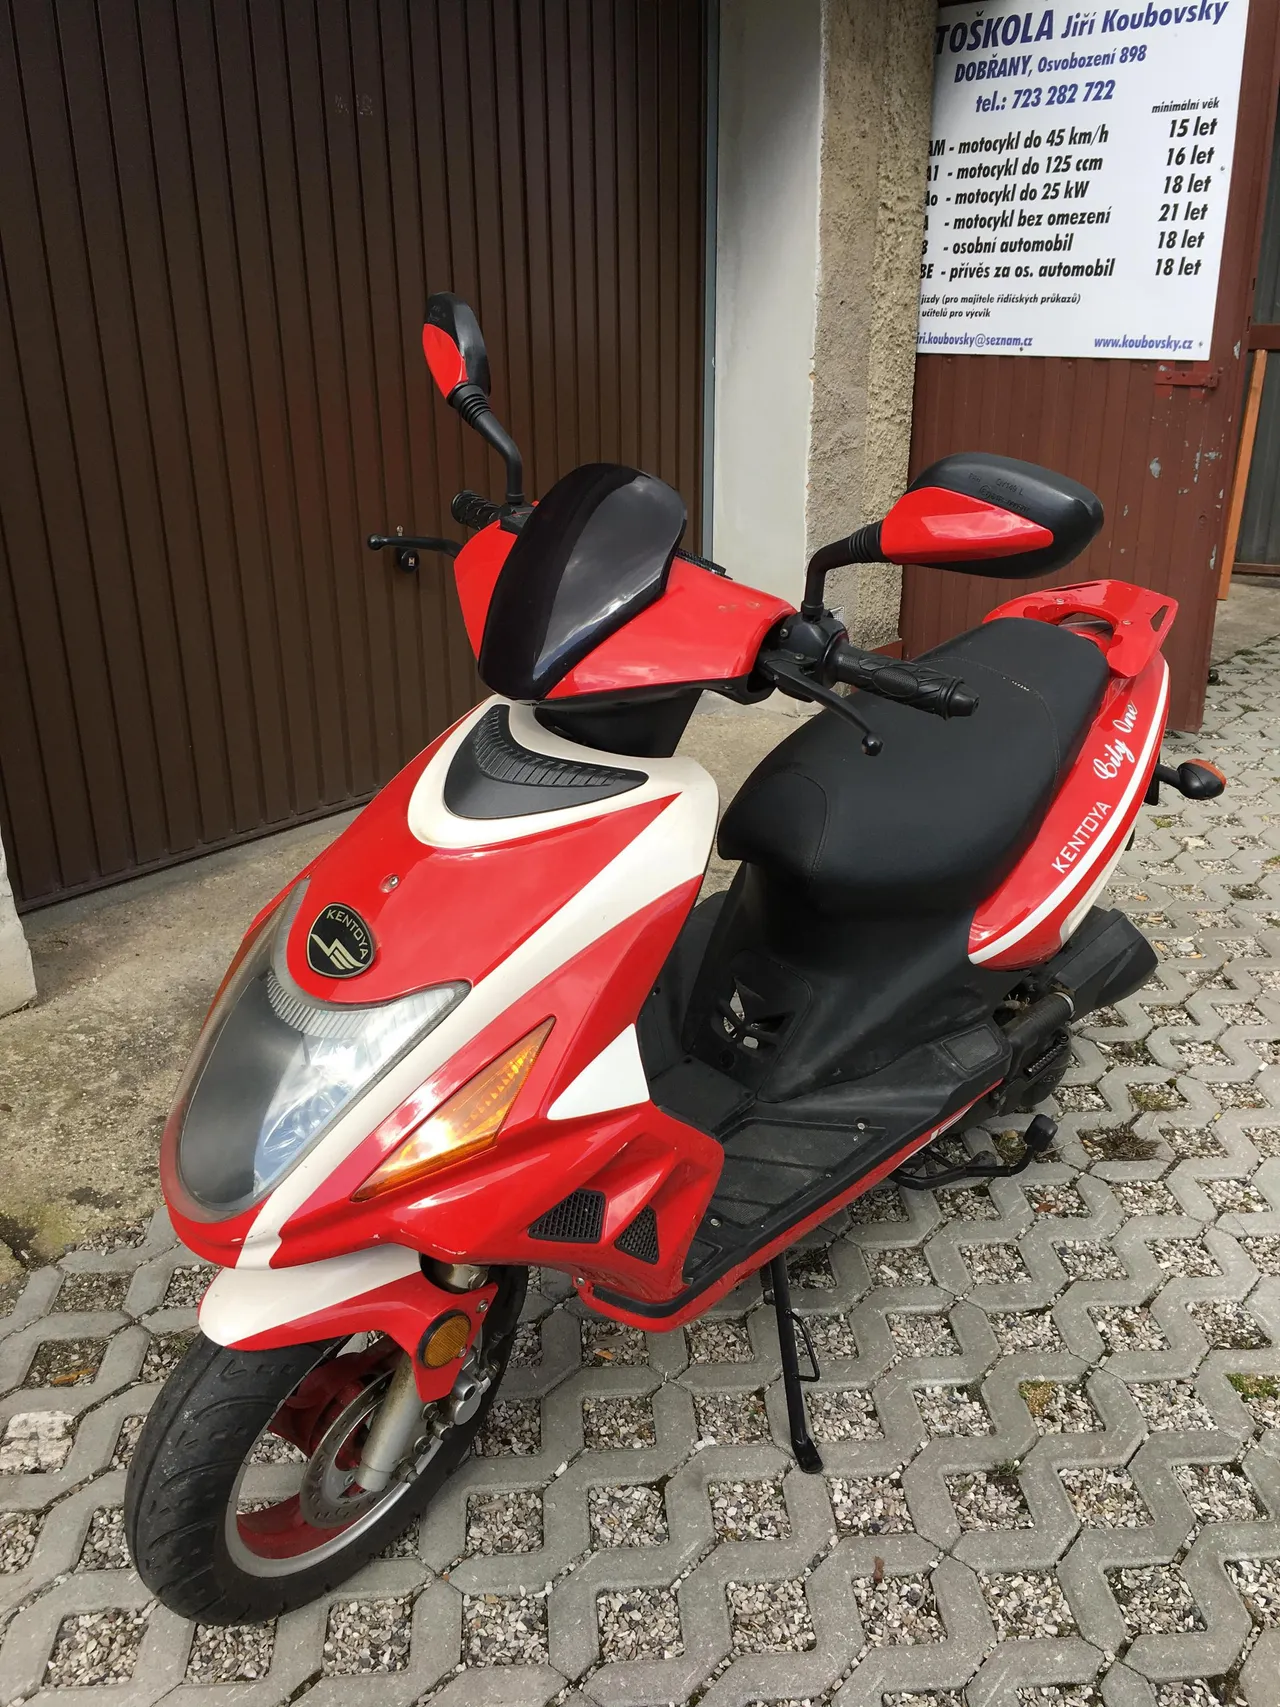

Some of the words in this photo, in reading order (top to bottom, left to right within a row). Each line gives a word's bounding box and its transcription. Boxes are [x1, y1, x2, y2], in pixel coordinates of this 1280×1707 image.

[1061, 12, 1097, 38] Jiří
[954, 53, 1033, 83] DOBŘANY,
[1038, 48, 1117, 73] Osvobození
[1119, 45, 1148, 64] 898
[975, 91, 1007, 113] tel.:
[1011, 87, 1042, 109] 723
[1045, 84, 1079, 106] 282
[1082, 79, 1116, 103] 722
[1151, 99, 1200, 113] minimální
[1202, 97, 1220, 110] věk
[1169, 118, 1190, 138] 15
[1193, 116, 1218, 136] let
[958, 131, 1021, 154] motocykl
[1023, 129, 1042, 149] do
[1046, 128, 1066, 147] 45
[1068, 123, 1109, 146] km/h
[1166, 147, 1186, 166] 16
[1190, 144, 1215, 165] let
[956, 157, 1019, 180] motocykl
[1022, 156, 1039, 175] do
[1045, 155, 1072, 173] 125
[1075, 157, 1103, 172] ccm
[954, 183, 1017, 206] motocykl
[1019, 182, 1037, 201] do
[1041, 182, 1061, 200] 25
[1063, 180, 1090, 199] kW
[1164, 174, 1184, 194] 18
[1187, 173, 1211, 193] let
[953, 209, 1015, 232] motocykl
[1017, 209, 1043, 227] bez
[1047, 206, 1112, 226] omezení
[1157, 203, 1179, 222] 21
[1184, 201, 1208, 221] let
[952, 236, 997, 254] osobní
[1000, 233, 1074, 253] automobil
[1158, 230, 1177, 249] 18
[1181, 229, 1205, 248] let
[948, 262, 990, 282] přívěs
[993, 265, 1011, 278] za
[1014, 265, 1034, 278] os.
[1039, 257, 1116, 278] automobil
[1155, 258, 1175, 276] 18
[1178, 256, 1202, 275] let
[942, 294, 959, 305] (pro
[960, 293, 995, 305] majitele
[996, 293, 1039, 305] řidičských
[1040, 292, 1081, 305] průkazů)
[921, 307, 948, 318] učitelů
[949, 310, 964, 319] pro
[965, 308, 991, 319] výcvik
[1094, 334, 1193, 352] www.koubovsky.cz
[1051, 801, 1112, 874] KENTOYA
[326, 909, 369, 960] KENTOYA
